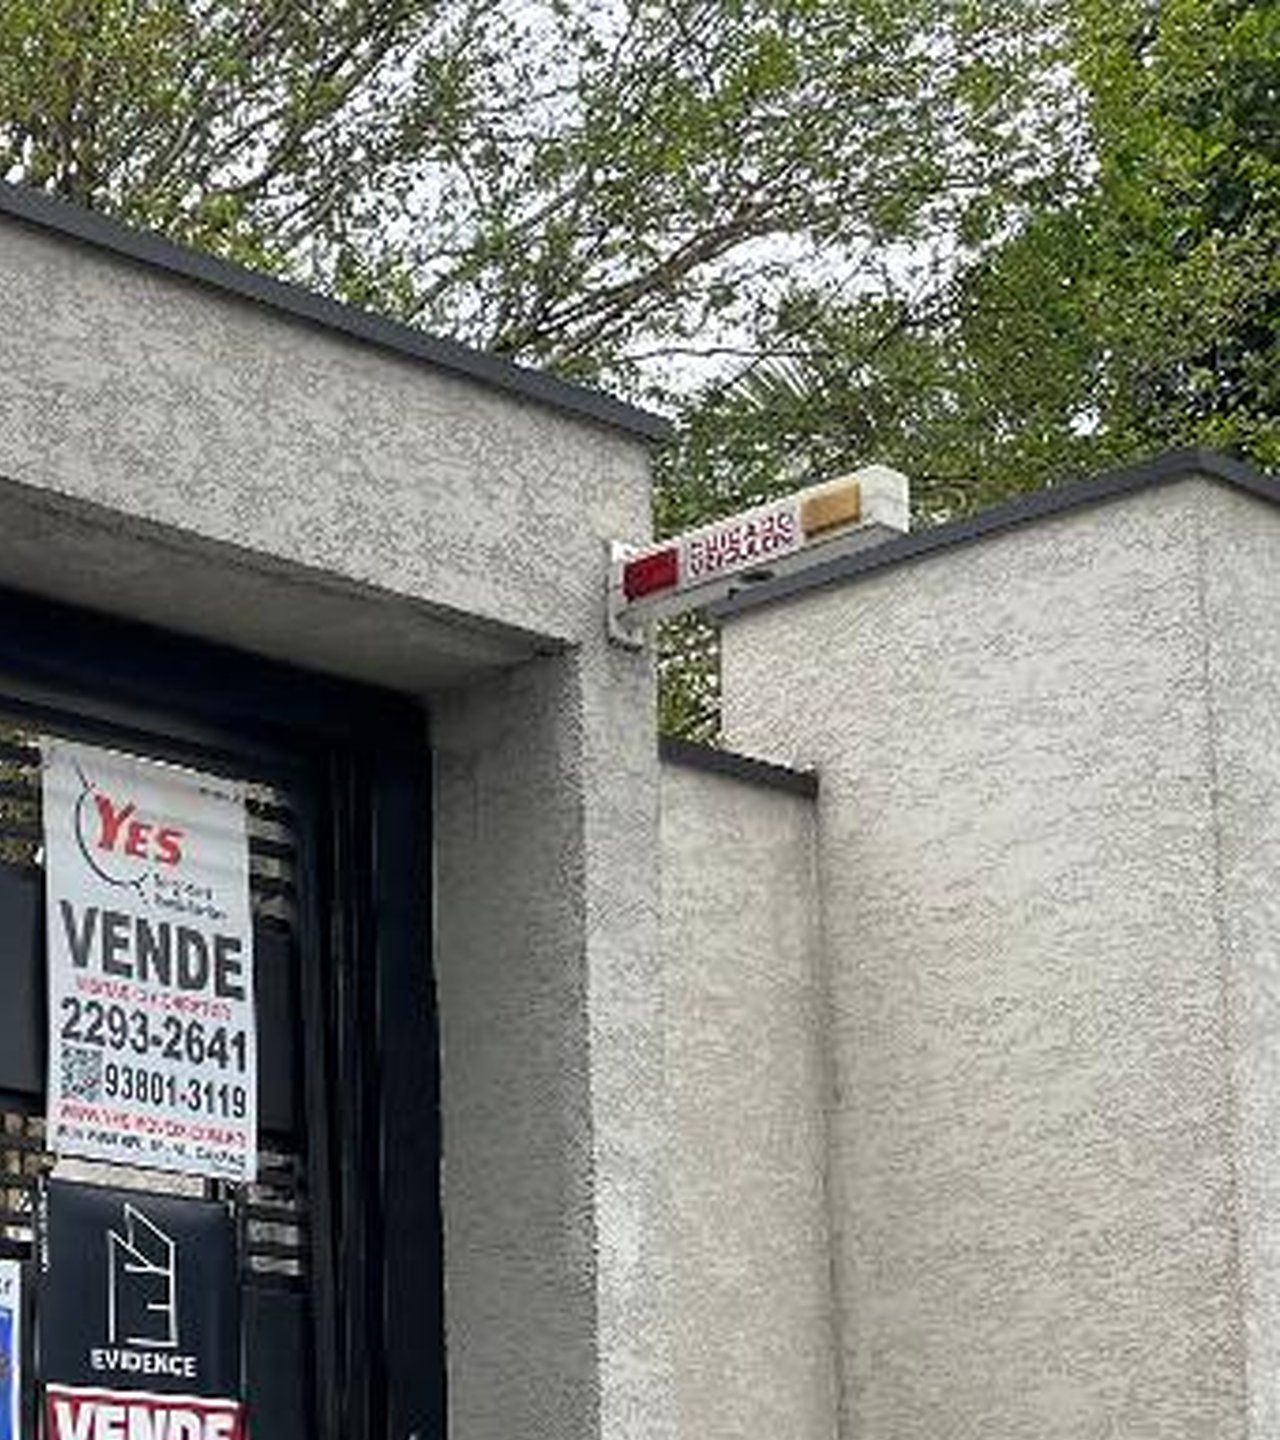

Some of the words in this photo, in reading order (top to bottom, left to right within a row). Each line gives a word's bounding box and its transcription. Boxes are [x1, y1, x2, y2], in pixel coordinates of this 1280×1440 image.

[94, 794, 184, 866] YES
[59, 899, 246, 1002] VENDE
[61, 996, 247, 1073] 2293-2641
[104, 1063, 247, 1119] 93801-3119
[90, 1348, 197, 1377] EVIDENCE
